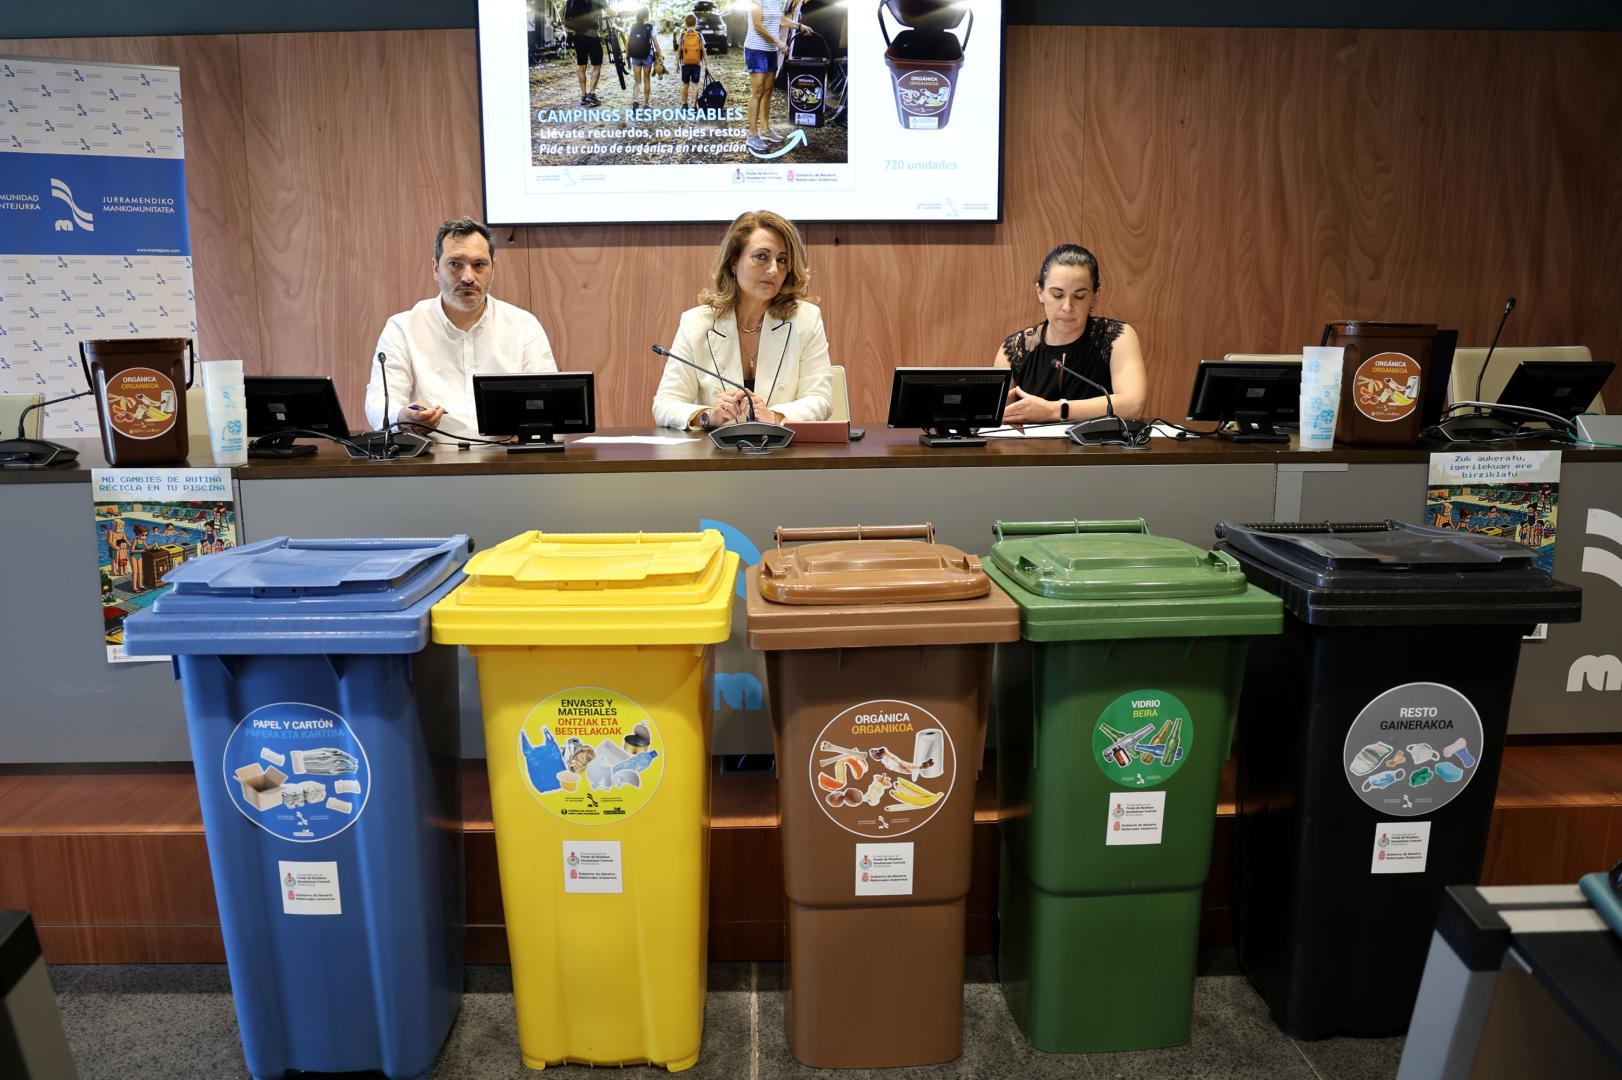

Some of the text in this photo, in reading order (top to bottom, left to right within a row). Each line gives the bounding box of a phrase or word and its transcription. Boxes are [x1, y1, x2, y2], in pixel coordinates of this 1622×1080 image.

[538, 108, 744, 123] CAMPINGS RESPONSABLES
[540, 127, 747, 139] Llévate recuerdos, no dejes restos
[540, 142, 747, 155] Pide tu cubo de orgánica en recepción
[884, 159, 958, 171] 720 unidades
[102, 196, 175, 206] JURRAMENDIKO
[102, 205, 175, 214] MANKOMUNITATEA
[561, 699, 613, 708] ENVASES Y
[1131, 699, 1161, 708] VIDRIO
[558, 707, 617, 716] MATERIALES
[1133, 709, 1159, 718] BEIRA
[1400, 707, 1438, 718] RESTO
[558, 718, 618, 726] ONTZIAK ETA
[855, 710, 910, 724] ORGÁNICA
[253, 718, 333, 730] PAPEL Y CARTÓN
[851, 723, 914, 735] ORGANIKOA
[1380, 720, 1454, 730] GAINERAKOA
[555, 727, 622, 736] BESTELAKOAK
